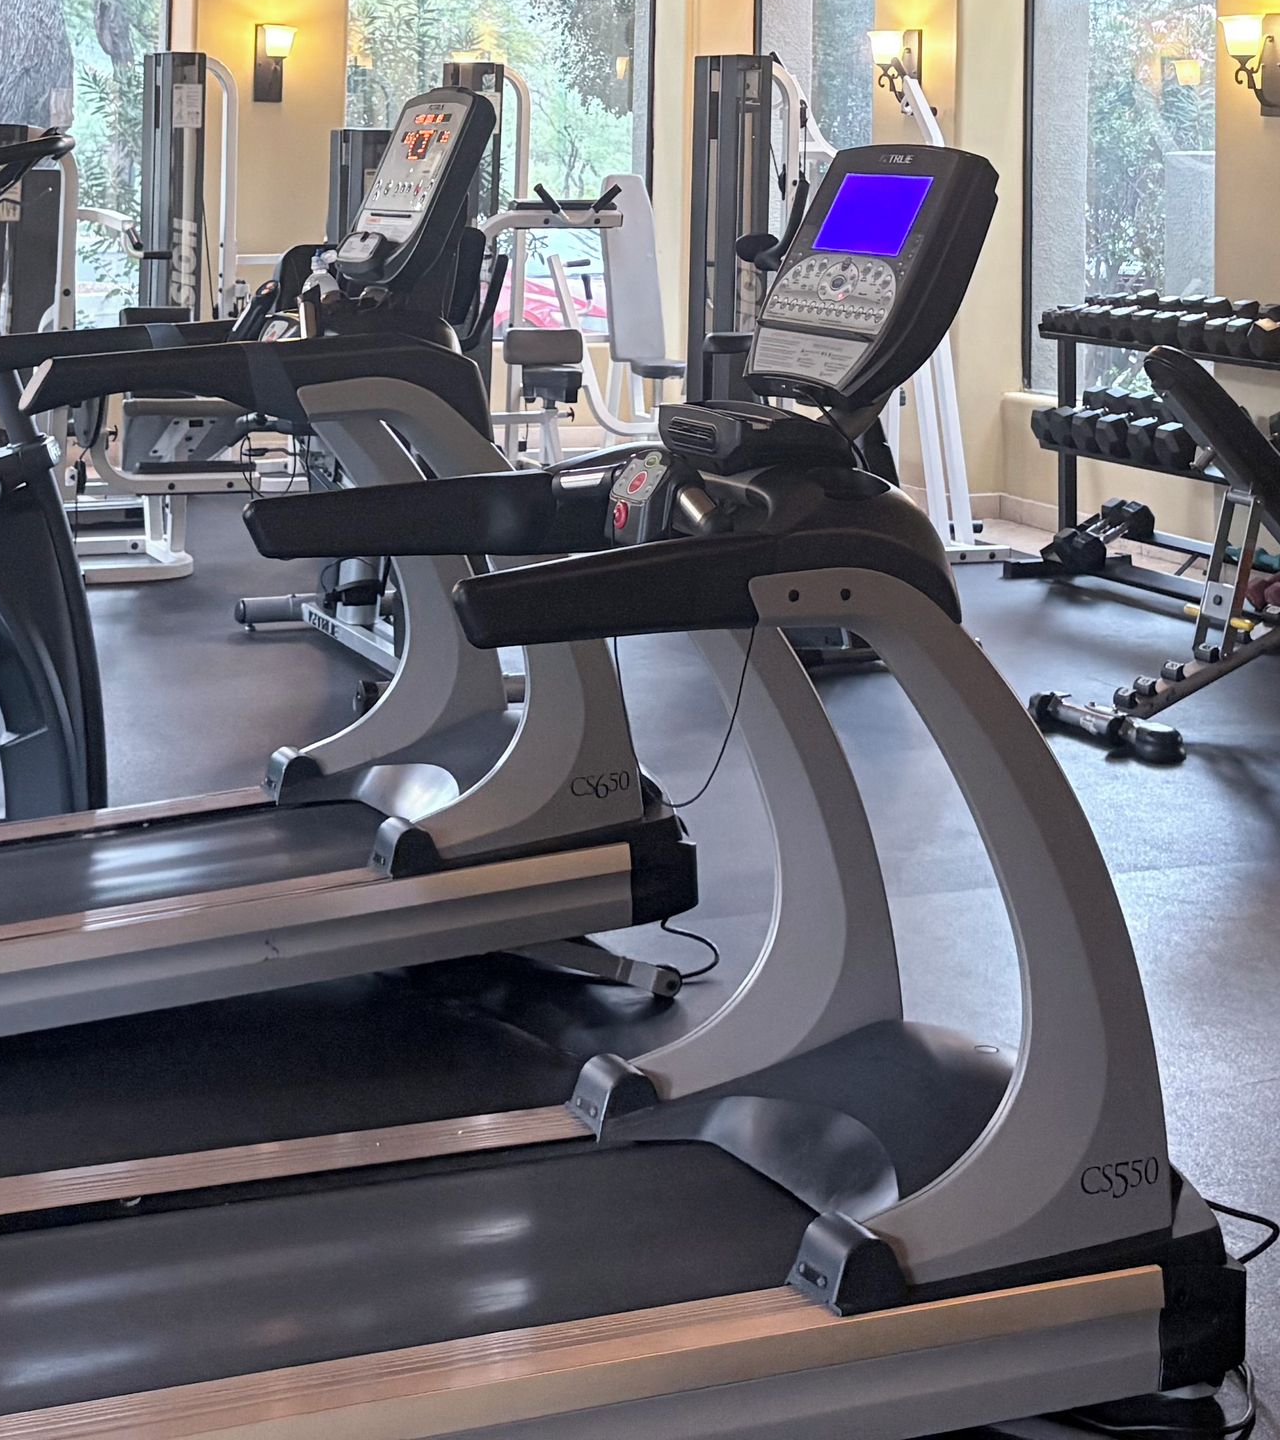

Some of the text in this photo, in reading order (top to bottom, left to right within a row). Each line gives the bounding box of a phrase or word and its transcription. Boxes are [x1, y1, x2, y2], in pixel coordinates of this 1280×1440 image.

[888, 154, 915, 164] TRUE
[171, 217, 198, 308] HOIS
[570, 770, 630, 799] CS650
[1080, 1156, 1159, 1199] CS550
